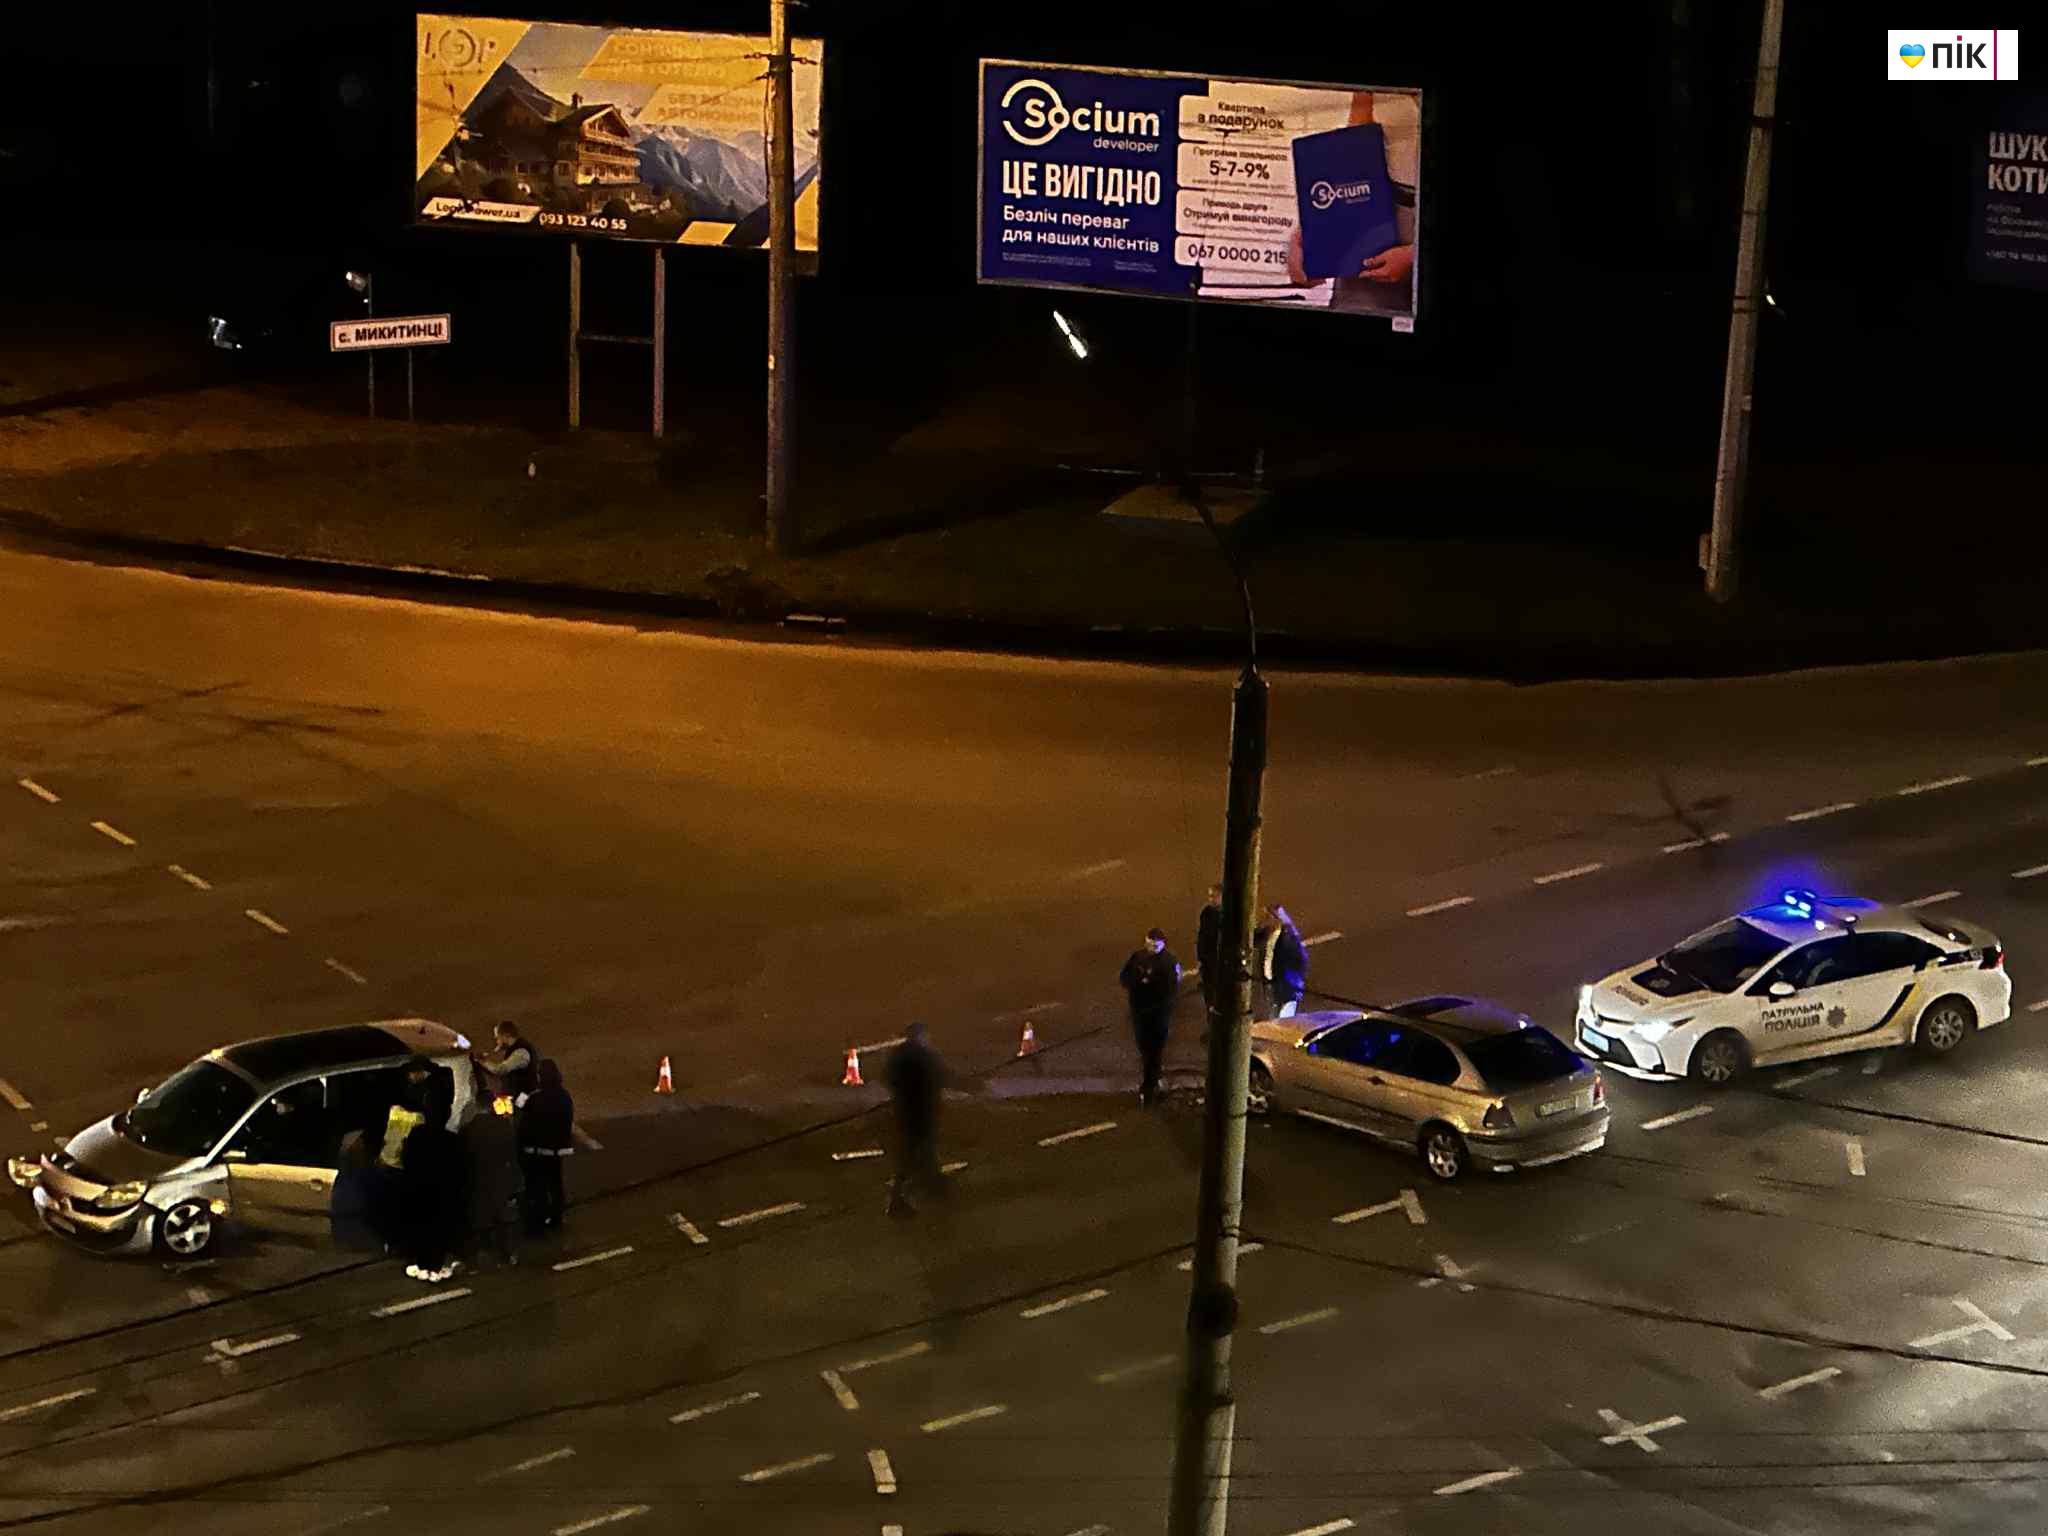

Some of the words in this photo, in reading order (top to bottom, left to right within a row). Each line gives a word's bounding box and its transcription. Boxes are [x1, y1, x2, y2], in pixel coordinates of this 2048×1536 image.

[1208, 114, 1285, 130] подарунок
[1093, 136, 1160, 154] developer
[1209, 160, 1270, 180] 5-7-9%
[1002, 160, 1038, 200] ЦЕ
[1045, 163, 1161, 207] ВИГІДНО
[539, 212, 563, 226] 093
[567, 214, 587, 227] 123
[590, 216, 608, 230] 40
[611, 218, 628, 231] 55
[1003, 205, 1058, 223] Безліч
[1061, 211, 1131, 230] переваг
[1002, 229, 1032, 244] для
[1037, 231, 1089, 247] наших
[1093, 236, 1160, 254] клієнтів
[1188, 243, 1215, 259] 067
[1218, 245, 1261, 263] 0000
[1264, 250, 1288, 264] 215
[338, 331, 351, 343] с.
[355, 322, 443, 342] МИКИТИНЦІ
[1761, 1002, 1825, 1021] ПАТРУЛЬНА
[1764, 1014, 1821, 1034] ПОЛІЦІЯ
